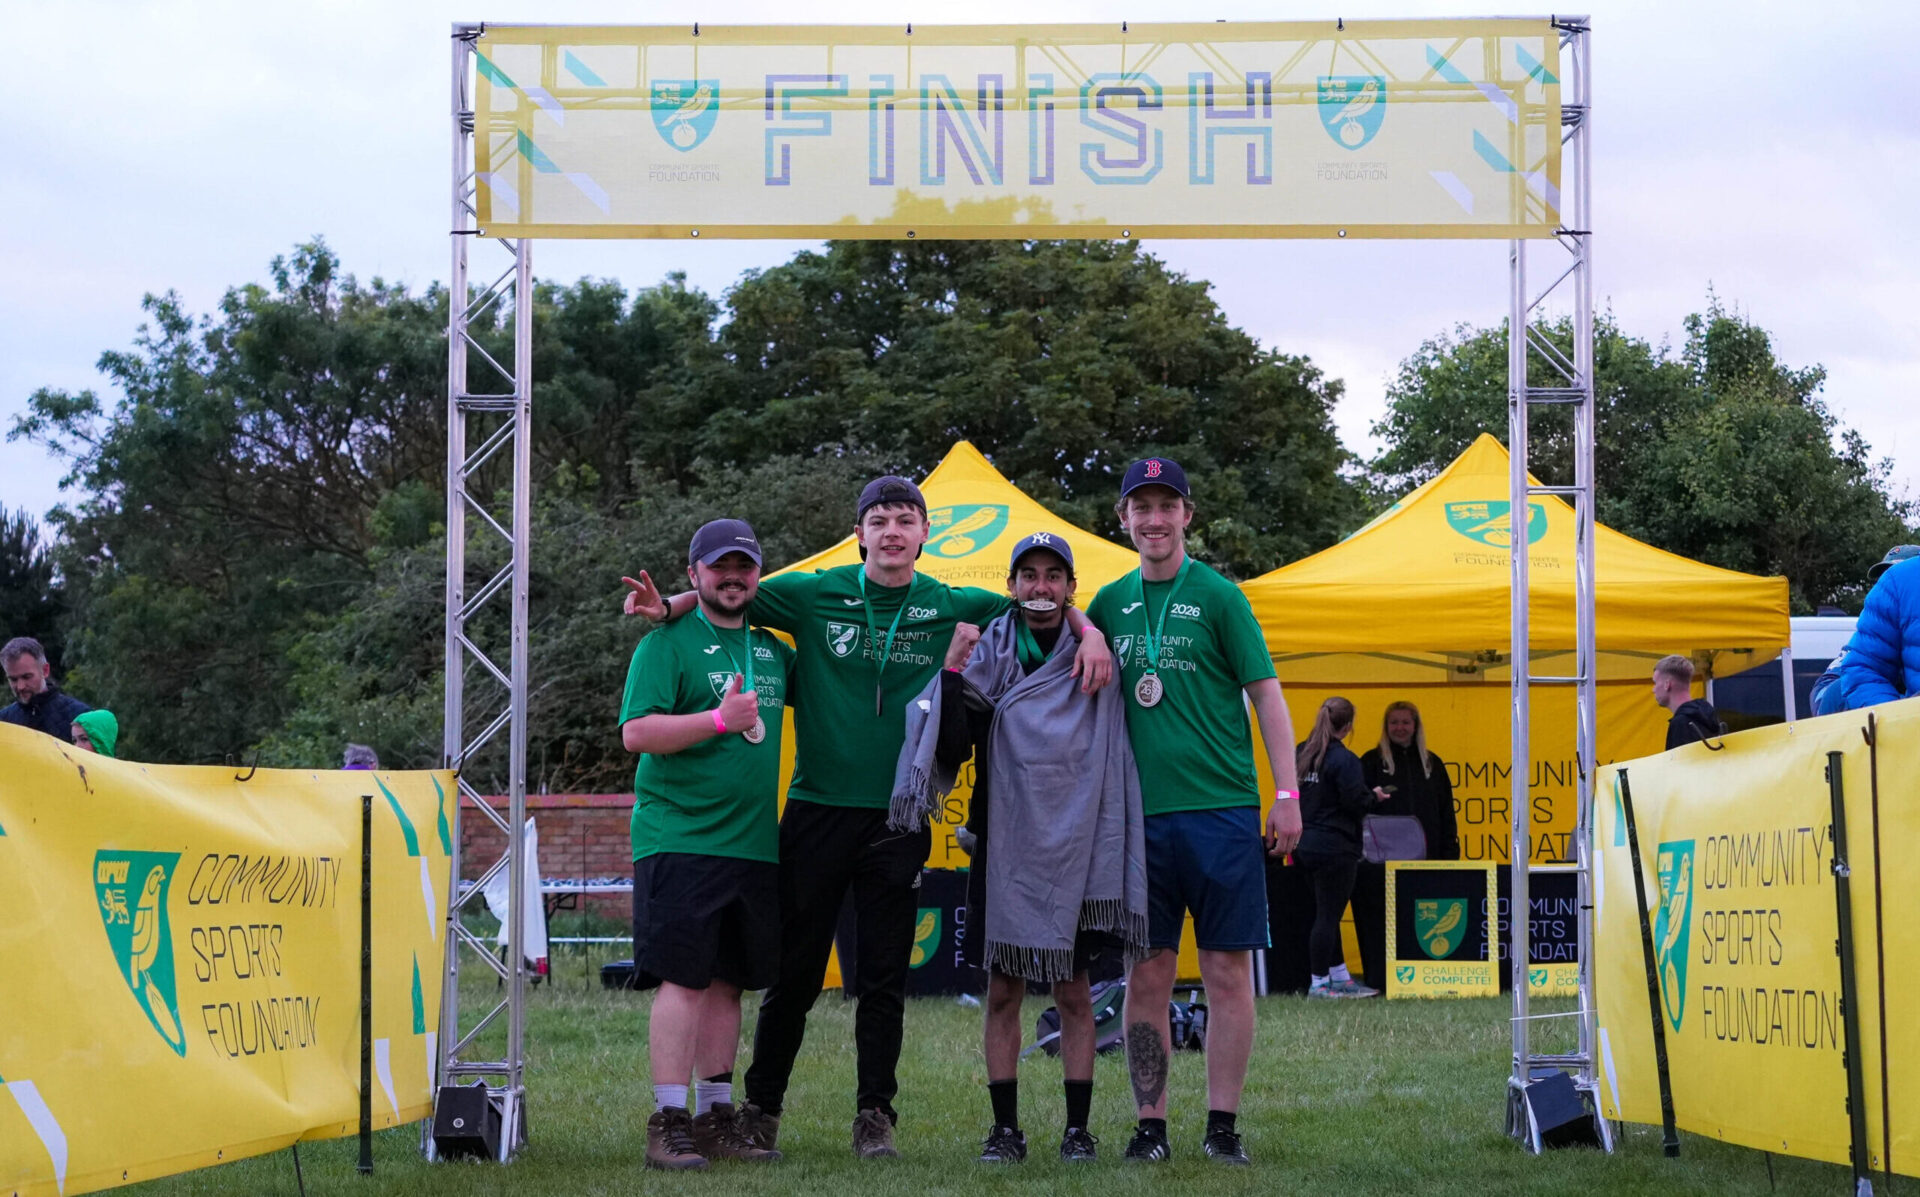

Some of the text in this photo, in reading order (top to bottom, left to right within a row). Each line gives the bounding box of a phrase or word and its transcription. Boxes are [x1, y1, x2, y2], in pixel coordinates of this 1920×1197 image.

[764, 71, 1273, 187] FINISH
[648, 171, 720, 182] FOUNDATION
[1316, 169, 1388, 181] FOUNDATION
[1144, 460, 1162, 478] B
[907, 607, 938, 619] 2026
[1170, 603, 1200, 618] 2026
[1704, 826, 1828, 890] COMMUNITY
[187, 853, 341, 909] COMMUNITY
[190, 924, 283, 983] SPORTS
[1702, 909, 1783, 966] SPORTS
[1422, 966, 1491, 976] CHALLENGE
[1423, 975, 1492, 985] COMPLETE!
[201, 996, 321, 1061] FOUNDATION
[1702, 985, 1838, 1051] FOUNDATION
